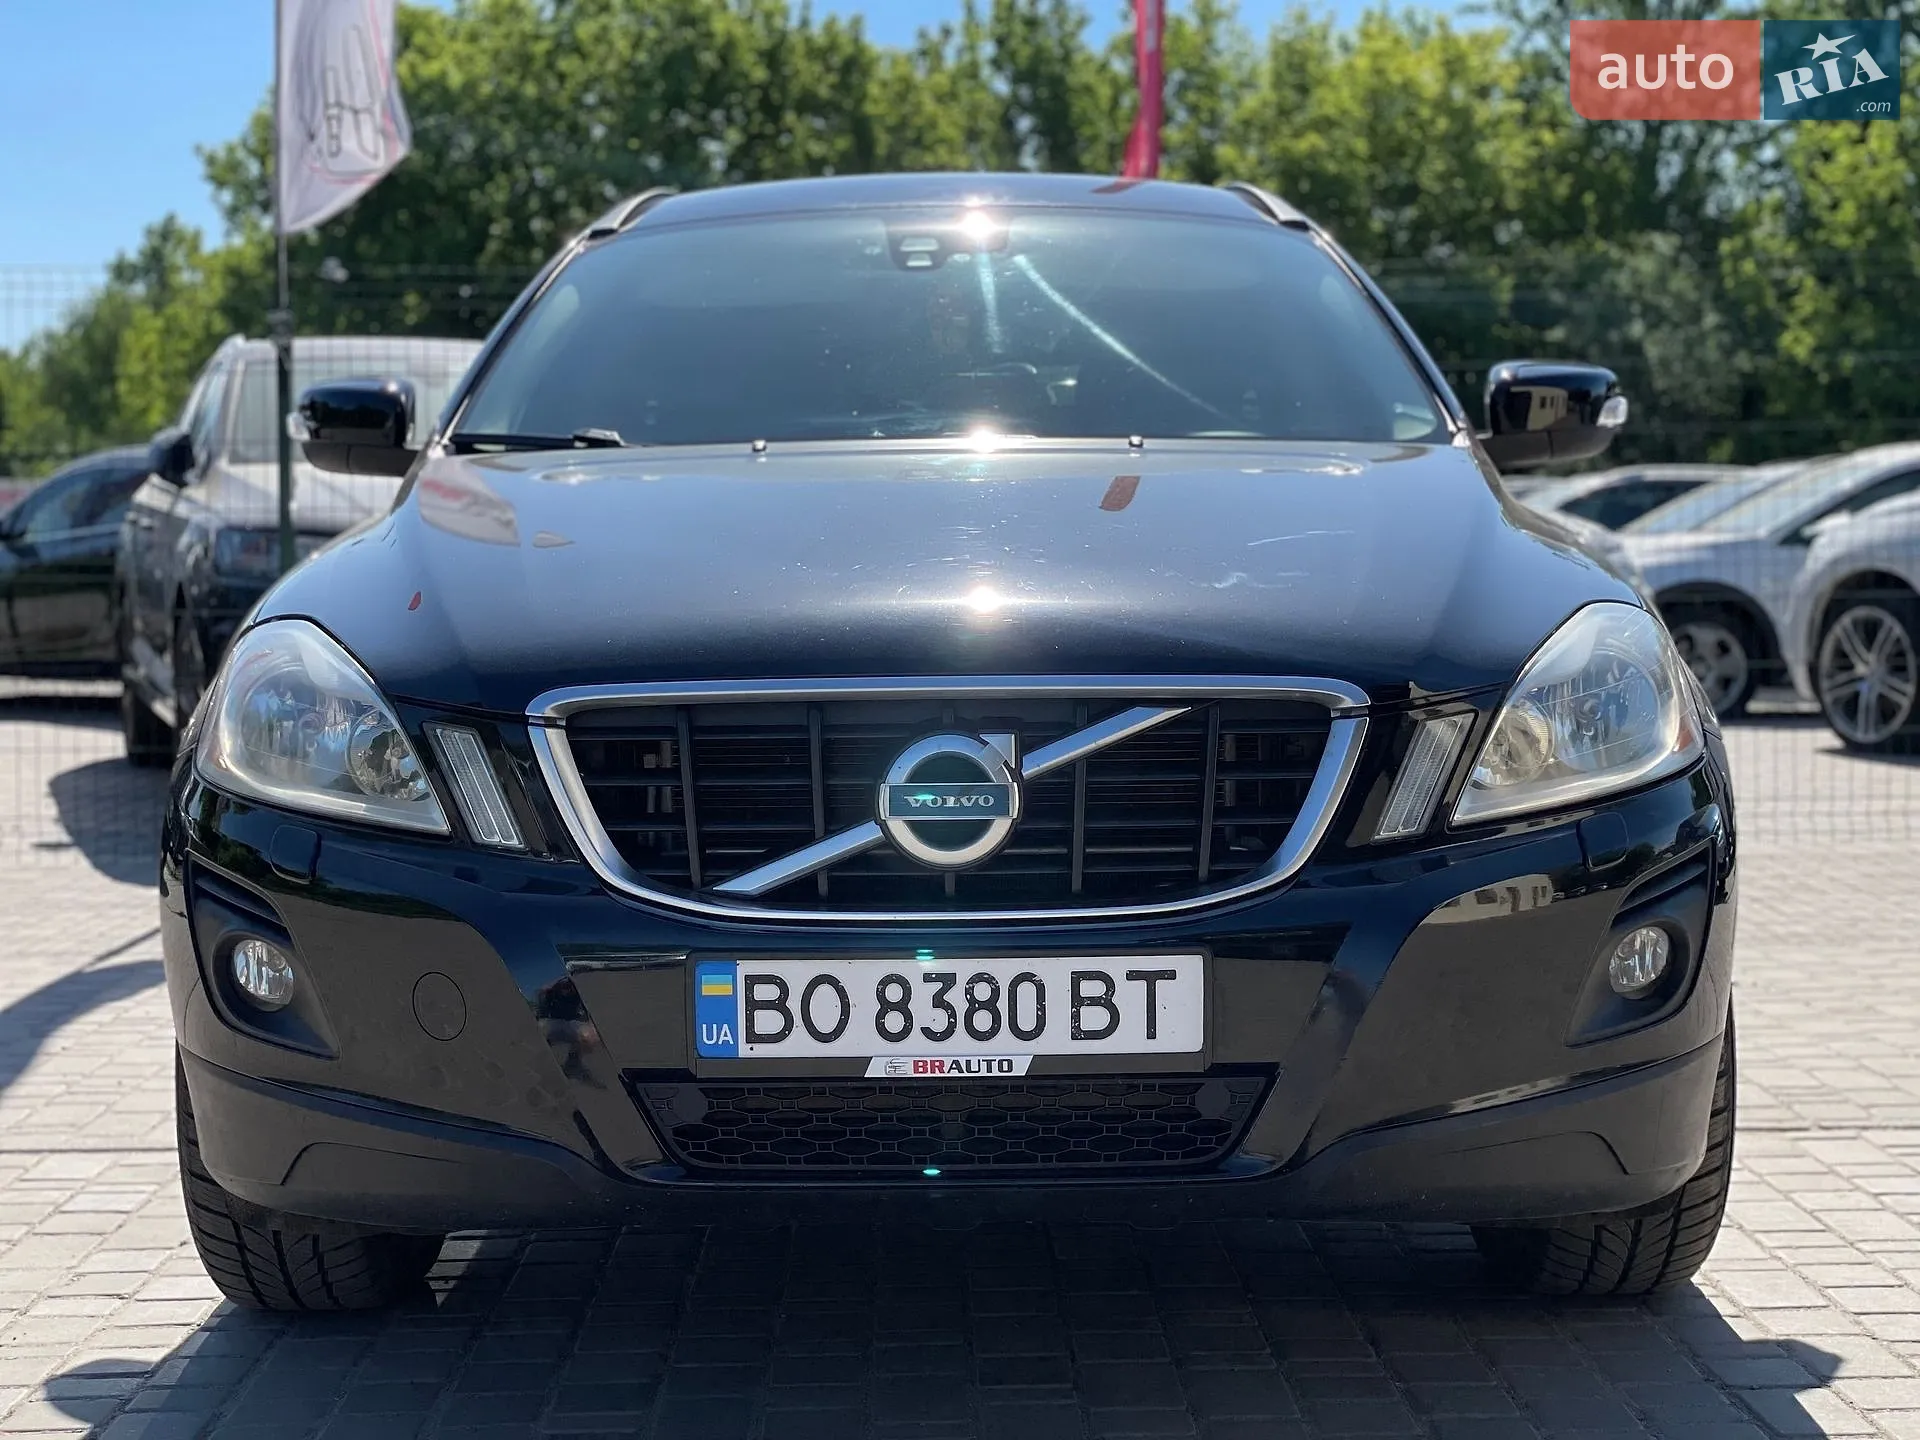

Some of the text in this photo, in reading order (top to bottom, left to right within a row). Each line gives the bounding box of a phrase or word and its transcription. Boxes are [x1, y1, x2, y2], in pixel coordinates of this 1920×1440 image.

[903, 794, 995, 808] VOLVO
[744, 970, 1178, 1044] BO 8380 BT
[702, 1023, 735, 1046] UA
[912, 1058, 1014, 1074] BRAUTO
